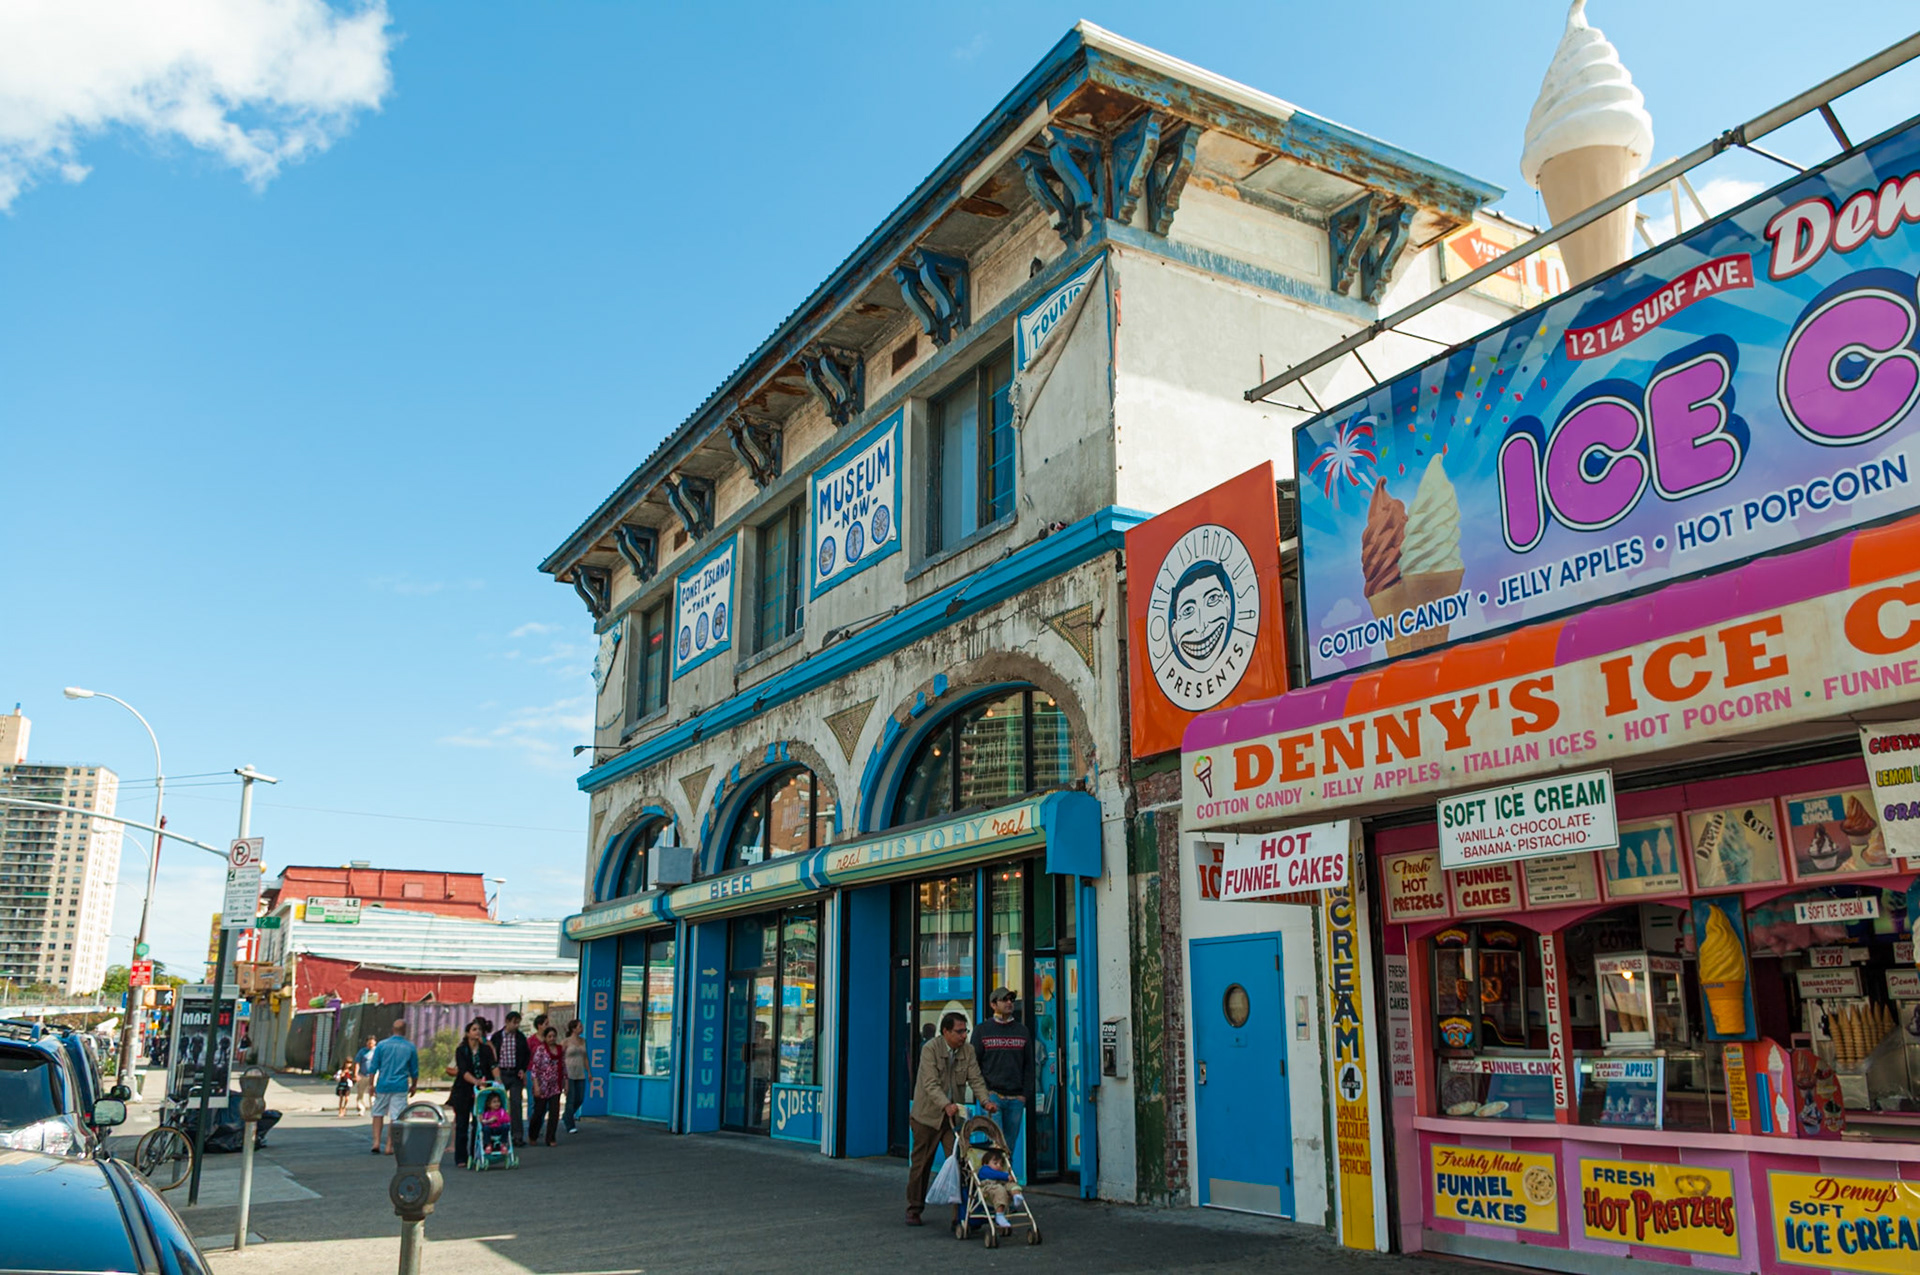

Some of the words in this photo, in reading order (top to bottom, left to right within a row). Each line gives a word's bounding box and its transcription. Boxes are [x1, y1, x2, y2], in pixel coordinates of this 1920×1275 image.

[1569, 324, 1626, 357] 1214
[1632, 280, 1688, 333] SURF
[1693, 260, 1748, 297] AVE.
[1497, 352, 1743, 555] ICE
[819, 439, 890, 525] MUSEUM
[1320, 613, 1394, 659] COTTON
[1400, 592, 1472, 635] CANDY
[1497, 565, 1552, 606] JELLY
[1559, 538, 1645, 588] APPLES
[1676, 509, 1735, 550] HOT
[1744, 454, 1909, 530] POPCORN
[703, 558, 730, 591] ISLAND
[1150, 561, 1176, 659] CONEY
[1165, 642, 1244, 699] PRESENTS
[1233, 674, 1560, 791] DENNY'S
[1600, 615, 1789, 717] ICE
[1196, 796, 1249, 820] COTTON
[1255, 787, 1303, 810] CANDY
[1322, 776, 1364, 799] JELLY
[1373, 762, 1441, 790] APPLES
[1463, 740, 1540, 774] ITALIAN
[1549, 729, 1598, 758] ICES
[1624, 714, 1670, 743] HOT
[1682, 687, 1793, 730] POCORN
[1876, 766, 1913, 787] LEMON
[1444, 800, 1486, 829] SOFT
[1495, 793, 1525, 820] ICE
[1534, 779, 1606, 813] CREAM
[1804, 800, 1828, 813] SUPER
[1457, 827, 1505, 844] VANILLA
[1510, 813, 1592, 836] CHOCOLATE
[1802, 811, 1833, 825] SUNDAE
[836, 848, 861, 870] real
[868, 818, 987, 864] HISTORY
[992, 809, 1025, 836] real
[1260, 832, 1312, 861] HOT
[1463, 841, 1513, 859] BANANA
[1518, 830, 1587, 851] PISTACHIO
[1696, 812, 1724, 862] Dream
[1741, 809, 1775, 843] Cone
[1224, 863, 1281, 896] FUNNEL
[1288, 853, 1343, 887] CAKES
[1392, 857, 1434, 875] Fresh
[1456, 865, 1513, 888] FUNNEL
[710, 874, 752, 900] BEER
[1401, 877, 1428, 893] HOT
[1462, 887, 1511, 907] CAKES
[1808, 905, 1824, 920] SOFT
[1827, 903, 1838, 918] ICE
[1840, 901, 1864, 917] CREAM
[1388, 965, 1407, 978] FRESH
[1621, 960, 1642, 970] CONES
[1330, 897, 1360, 1063] CREAM
[1389, 981, 1408, 994] FUNNEL
[1390, 998, 1409, 1011] CAKES
[182, 1012, 212, 1025] MAFI
[1542, 940, 1557, 1024] FUNNEL
[1550, 1033, 1565, 1105] CAKES
[589, 992, 608, 1098] BEER
[697, 983, 718, 1109] MUSEUM
[1394, 1041, 1408, 1051] CANDY
[1393, 1054, 1412, 1065] CARAMEL
[1481, 1061, 1527, 1074] FUNNEL
[1595, 1062, 1623, 1070] CARAMEL
[1625, 1063, 1653, 1078] APPLES
[1342, 1067, 1361, 1099] 4
[1394, 1070, 1413, 1086] APPLES
[1602, 1070, 1623, 1078] CANDY
[1337, 1105, 1369, 1121] VANILLA
[1337, 1121, 1369, 1140] CHOCOLATE
[1338, 1140, 1365, 1157] BANANA
[1340, 1158, 1371, 1177] PISTACHIO
[1437, 1152, 1489, 1174] Freshly
[1485, 1153, 1524, 1174] Made
[1437, 1173, 1513, 1197] FUNNEL
[1593, 1167, 1655, 1187] FRESH
[1809, 1178, 1898, 1212] Denny's
[1456, 1198, 1527, 1224] CAKES
[1789, 1201, 1844, 1218] SOFT
[1785, 1217, 1832, 1254] ICE
[1837, 1215, 1920, 1254] CREA
